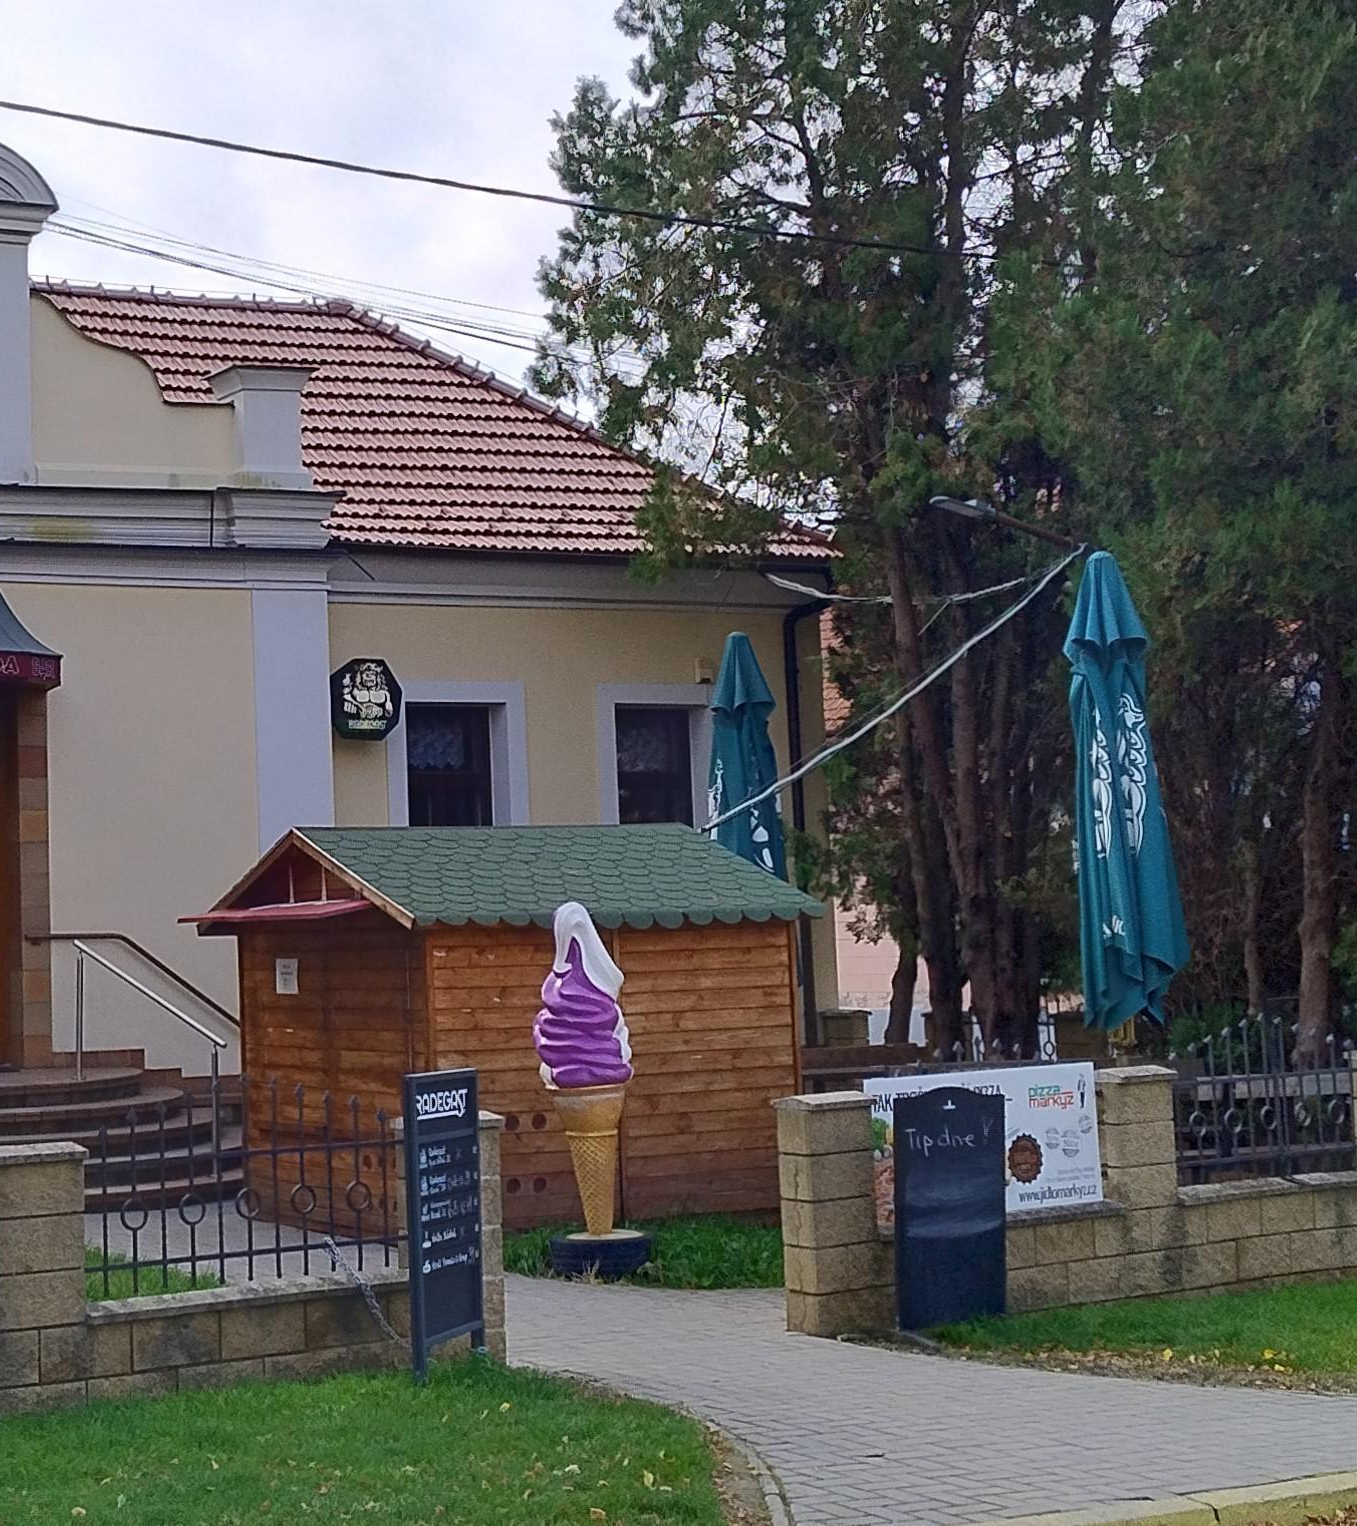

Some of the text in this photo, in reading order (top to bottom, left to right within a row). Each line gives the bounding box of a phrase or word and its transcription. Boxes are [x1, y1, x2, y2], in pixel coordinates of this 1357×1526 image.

[416, 1089, 468, 1118] RADEGAST
[1028, 1084, 1061, 1098] pizza
[904, 1128, 933, 1157] Tip
[937, 1123, 976, 1148] dne
